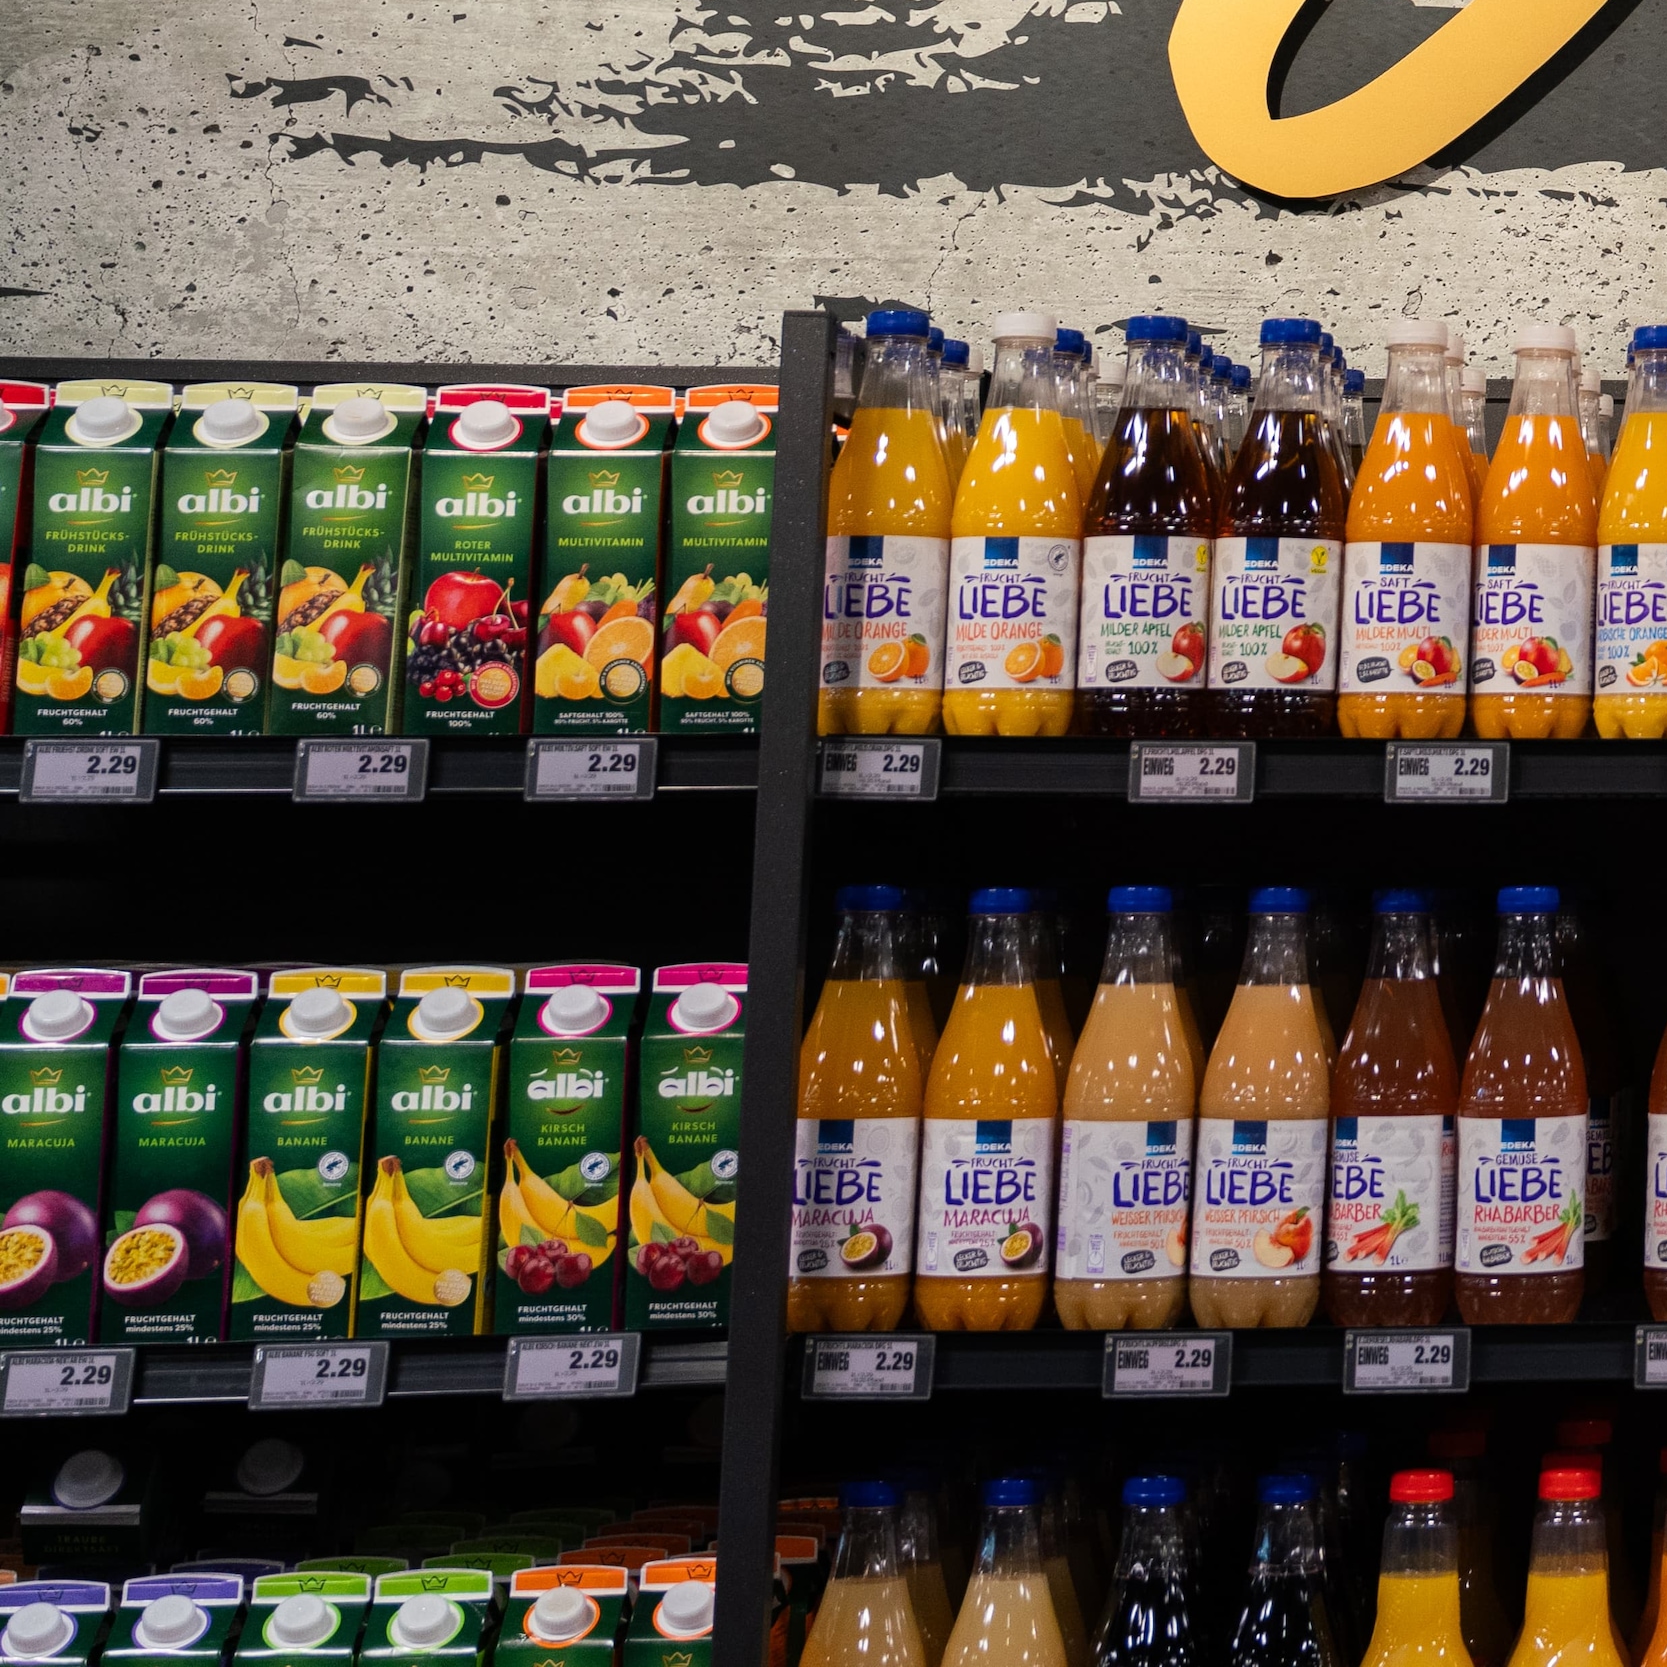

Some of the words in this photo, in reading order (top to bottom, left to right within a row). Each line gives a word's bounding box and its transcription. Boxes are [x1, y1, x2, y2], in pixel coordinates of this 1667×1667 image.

[48, 486, 132, 513] albi
[178, 486, 261, 513] albi
[306, 482, 389, 511] albi
[435, 491, 518, 519] albi
[562, 487, 643, 514] albi
[686, 487, 767, 514] albi
[68, 542, 106, 554] DRINK
[324, 538, 362, 550] DRINK
[454, 540, 492, 551] ROTER
[558, 536, 644, 548] MULTIVITAMIN
[431, 550, 514, 563] MULTIVITAMIN
[984, 558, 1019, 569] EDEKA
[1132, 558, 1168, 569] EDEKA
[980, 574, 1021, 584] FRUCHT
[1380, 564, 1414, 574] EDEKA
[1380, 577, 1410, 588] SAFT
[958, 584, 1046, 619] LIEBE
[1104, 584, 1192, 618] LIEBE
[1221, 585, 1306, 618] LIEBE
[1354, 590, 1441, 625] LIEBE
[990, 620, 1042, 640] ORANGE
[37, 707, 108, 718] FRUCHTGEHALT
[62, 716, 83, 726] 60%
[425, 709, 495, 720] FRUCHTGEHALT
[448, 718, 472, 728] 100%
[87, 754, 137, 775] 2.29
[358, 753, 408, 774] 2.29
[588, 752, 637, 773] 2.29
[883, 754, 920, 773] 2.29
[1143, 757, 1174, 776] EINWEG
[1199, 757, 1236, 776] 2.29
[1400, 758, 1429, 776] EINWEG
[1454, 758, 1490, 776] 2.29
[527, 1072, 604, 1100] albi
[658, 1071, 734, 1098] albi
[1, 1085, 86, 1113] albi
[132, 1085, 217, 1113] albi
[263, 1084, 346, 1112] albi
[391, 1085, 474, 1112] albi
[541, 1123, 586, 1134] KIRSCH
[138, 1136, 206, 1149] MARACUJA
[277, 1135, 328, 1147] BANANE
[538, 1135, 588, 1146] BANANE
[944, 1170, 1037, 1206] LIEBE
[1205, 1170, 1295, 1206] LIEBE
[944, 1208, 1030, 1227] MARACUJA
[518, 1304, 588, 1314] FRUCHTGEHALT
[569, 1349, 619, 1371] 2.29
[875, 1351, 914, 1373] 2.29
[1174, 1348, 1212, 1370] 2.29
[1414, 1346, 1451, 1367] 2.29
[60, 1365, 112, 1387] 2.29
[317, 1358, 367, 1380] 2.29
